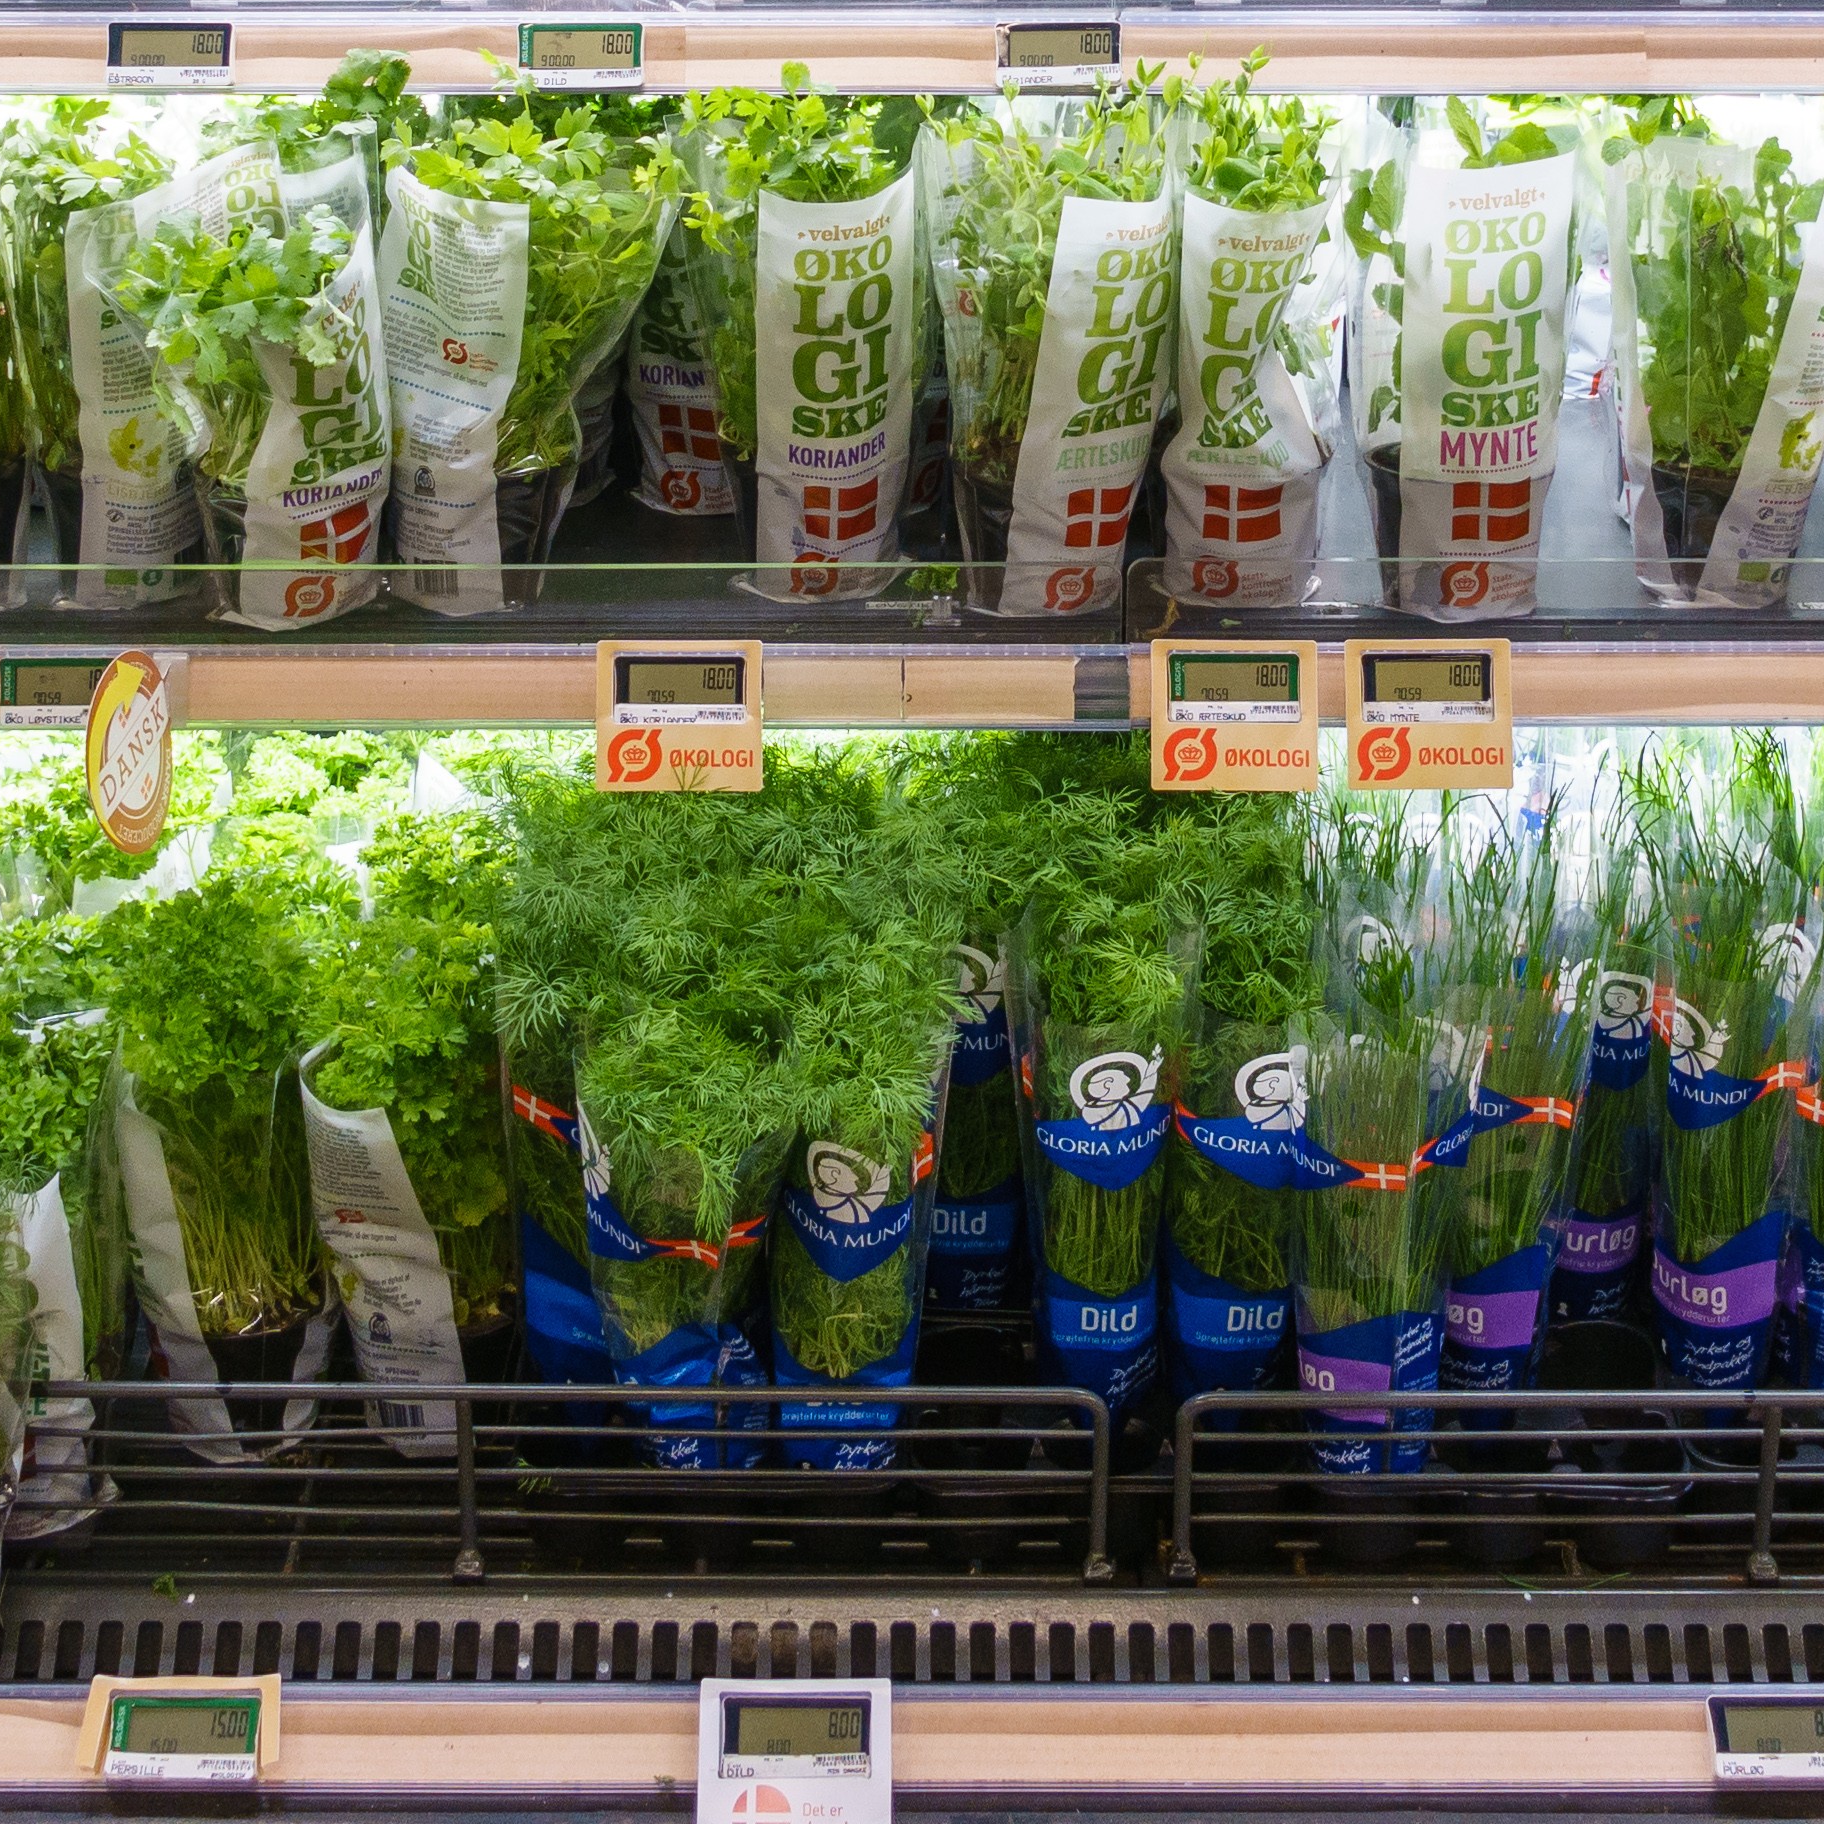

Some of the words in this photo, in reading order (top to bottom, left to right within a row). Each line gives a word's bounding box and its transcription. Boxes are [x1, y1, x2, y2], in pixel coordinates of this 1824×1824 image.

[190, 32, 224, 55] 18.00
[600, 33, 634, 56] 18.00
[107, 75, 155, 84] ESTRAGON
[1459, 186, 1539, 212] velvalgt
[806, 217, 884, 241] velvalgt
[1445, 211, 1547, 254] ØKO
[794, 236, 894, 281] ØKO
[1442, 250, 1544, 314] LO
[792, 272, 893, 335] LO
[1441, 312, 1542, 388] GI
[792, 331, 891, 397] GI
[792, 388, 886, 437] SKE
[1440, 381, 1541, 430] SKE
[787, 431, 886, 470] KORIANDER
[1439, 421, 1539, 467] MYNTE
[1255, 664, 1289, 687] 18.00
[1448, 664, 1481, 687] 18.00
[4, 714, 24, 725] ØKO
[27, 714, 82, 725] LØVSTIKKE
[1175, 711, 1196, 722] ØKO
[1198, 711, 1247, 722] ÆRTESKUD
[1365, 713, 1386, 722] ØKO
[1389, 713, 1421, 722] MYNTE
[99, 699, 165, 809] DANSK
[668, 748, 755, 770] ØKOLOGI
[1225, 747, 1310, 770] ØKOLOGI
[1417, 745, 1505, 766] ØKOLOGI
[1682, 1081, 1749, 1106] MUNDI
[1037, 1124, 1112, 1157] GLORIA
[1193, 1124, 1270, 1158] GLORIA
[843, 1212, 913, 1248] MUNDI
[932, 1207, 987, 1236] Dild
[1080, 1305, 1138, 1334] Dild
[1226, 1304, 1284, 1333] Dild
[208, 1711, 249, 1737] 15.00
[827, 1710, 861, 1738] 8.00
[110, 1764, 165, 1776] PERSILLE
[725, 1766, 755, 1777] DILD
[1722, 1764, 1766, 1775] PURLØG
[801, 1802, 827, 1817] Det
[830, 1806, 845, 1817] er
